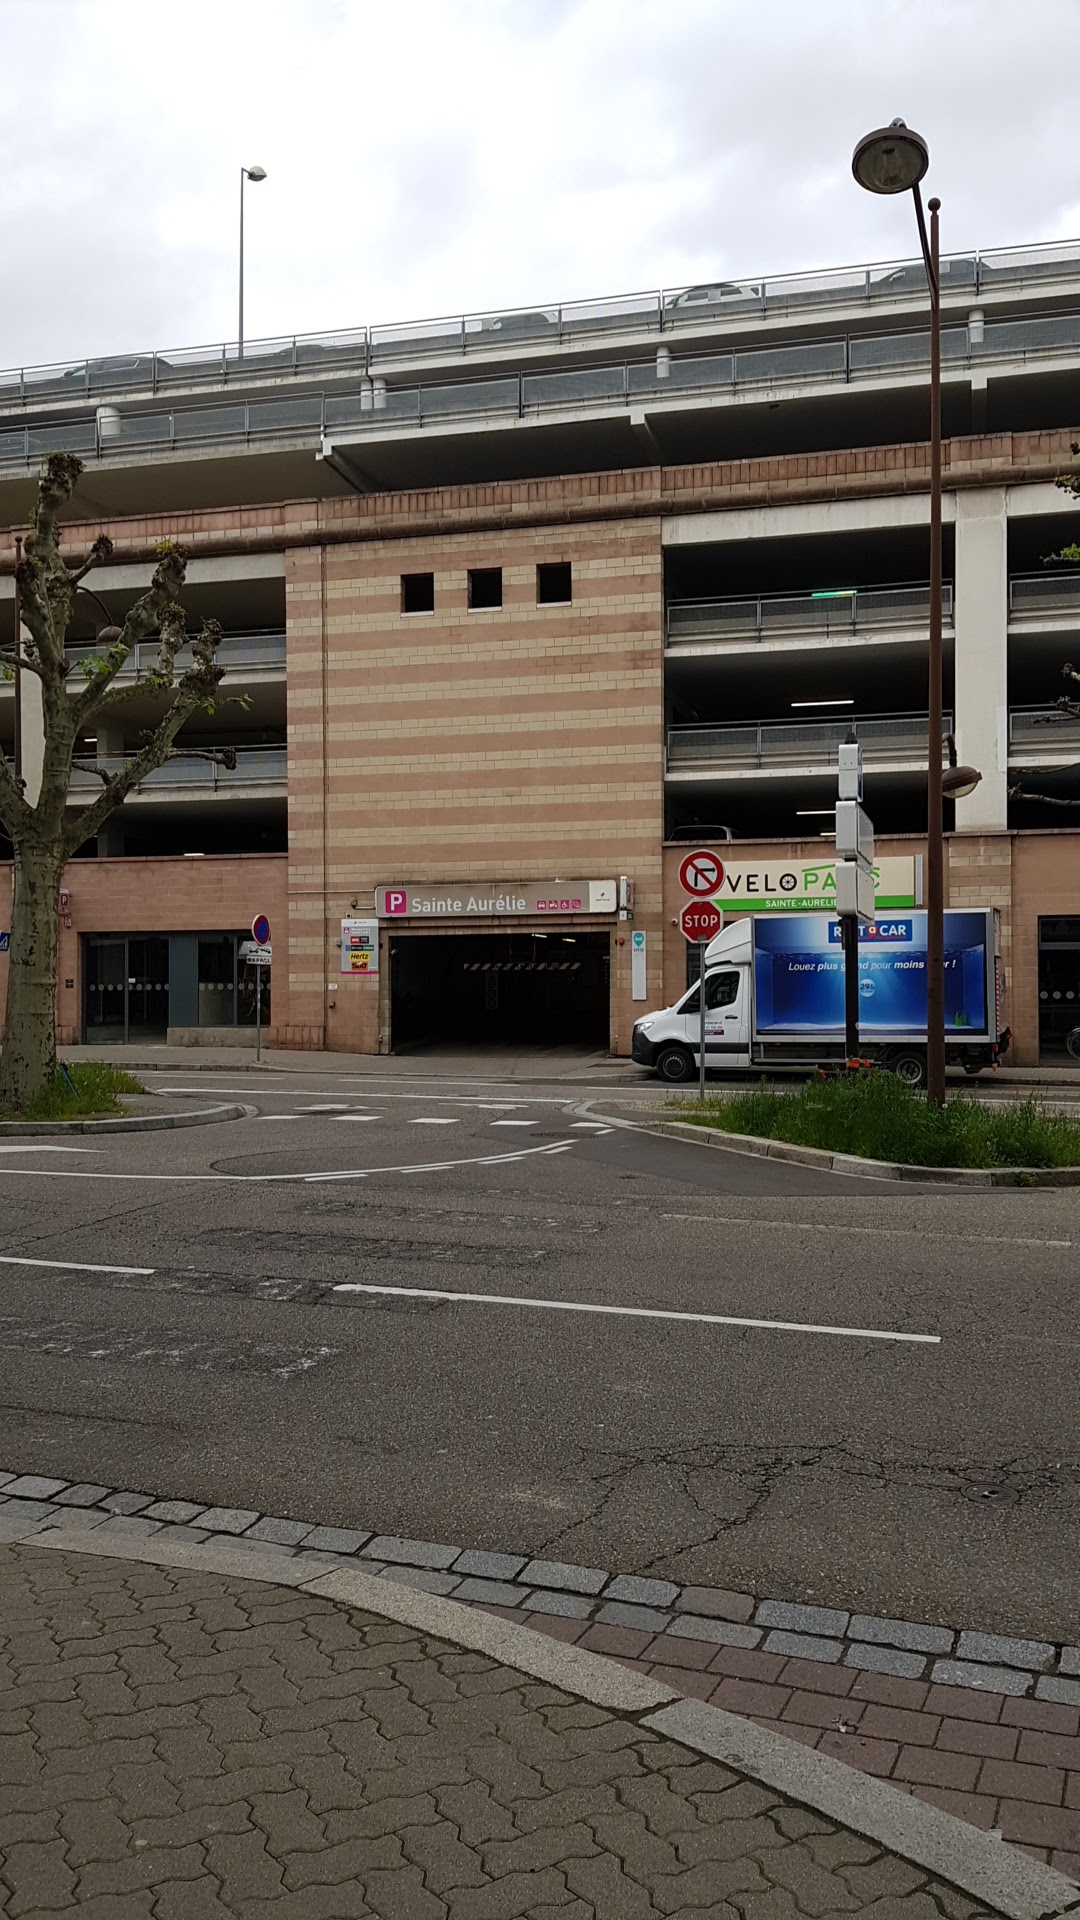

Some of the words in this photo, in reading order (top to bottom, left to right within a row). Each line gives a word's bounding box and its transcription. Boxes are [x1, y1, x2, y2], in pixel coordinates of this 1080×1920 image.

[390, 893, 403, 911] P
[411, 898, 462, 912] Sainte
[466, 894, 526, 912] Aurélie
[685, 914, 718, 928] STOP
[834, 926, 866, 937] RT
[879, 925, 906, 936] CAR
[788, 962, 815, 971] Louez
[817, 961, 838, 972] plus
[840, 961, 869, 972] gnd
[871, 962, 892, 971] pour
[894, 960, 924, 969] moins
